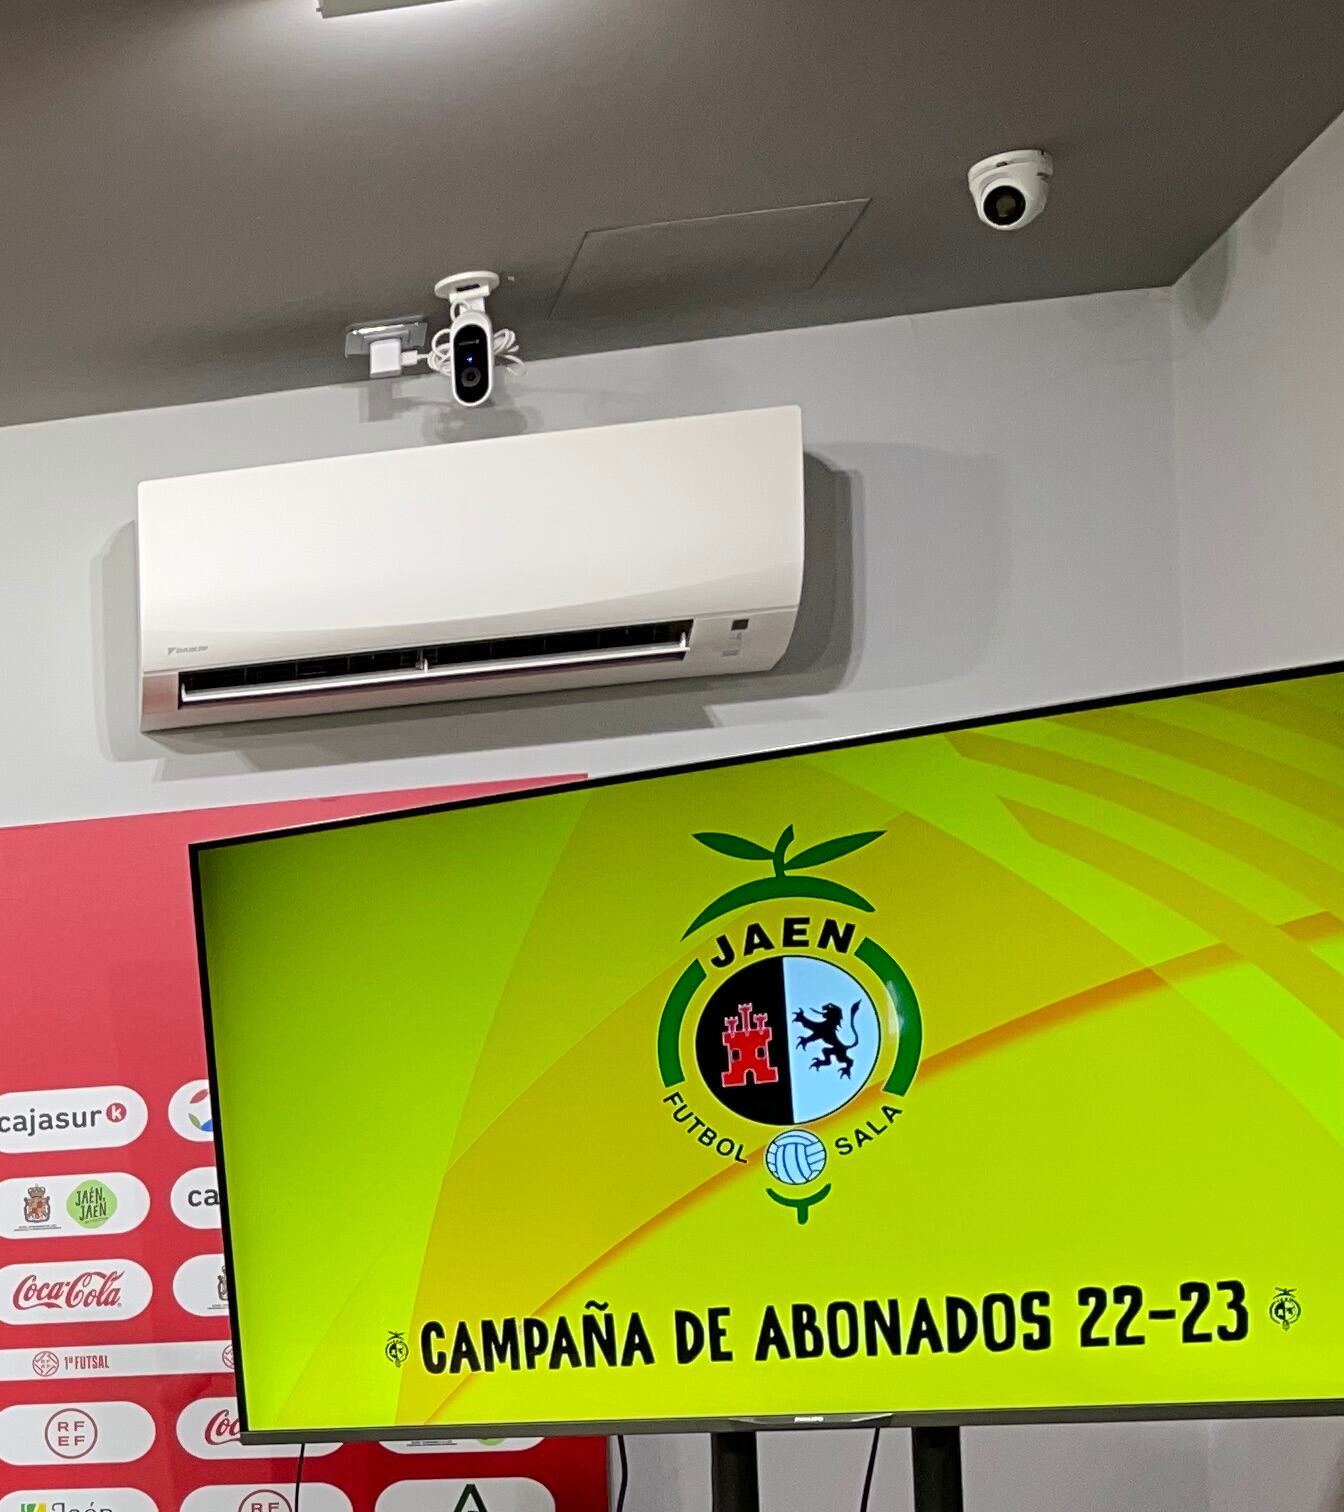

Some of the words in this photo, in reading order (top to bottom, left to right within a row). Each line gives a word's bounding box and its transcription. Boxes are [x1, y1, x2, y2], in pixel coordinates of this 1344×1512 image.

[711, 917, 856, 968] JAEN
[663, 1092, 748, 1163] FUTBOL
[835, 1104, 903, 1155] SALA
[12, 1271, 125, 1310] Coca-Cola
[420, 1300, 655, 1374] CAMPAÑA
[674, 1308, 733, 1365] DE
[755, 1290, 1052, 1362] ABONADOS
[1077, 1280, 1250, 1348] 22-23
[75, 1355, 109, 1369] FUTSAL
